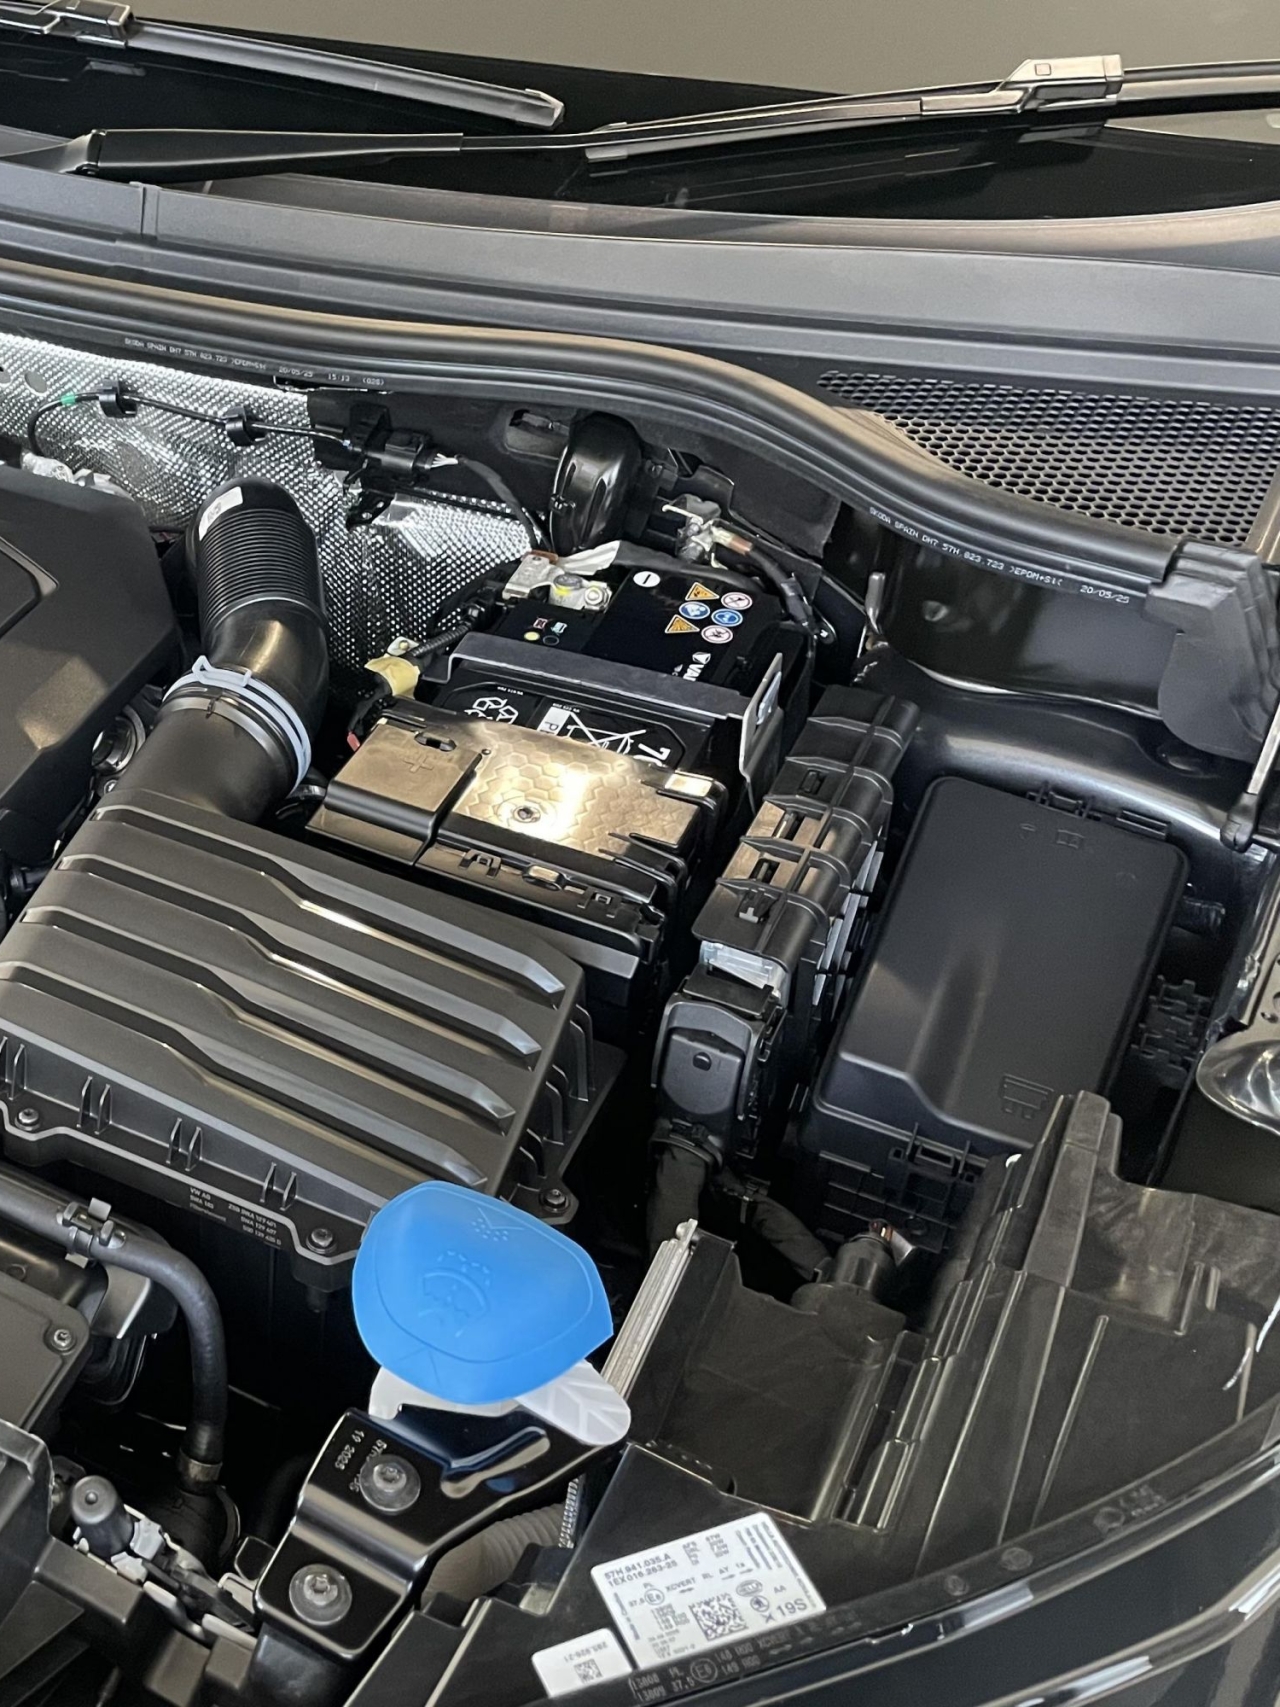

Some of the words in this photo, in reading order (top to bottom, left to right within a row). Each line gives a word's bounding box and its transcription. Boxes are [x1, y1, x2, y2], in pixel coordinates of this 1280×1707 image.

[870, 507, 891, 524] SKODA
[894, 519, 919, 539] SPAIN
[922, 535, 938, 547] DH7
[1080, 585, 1130, 604] 20/05/25
[776, 1598, 808, 1617] 19S
